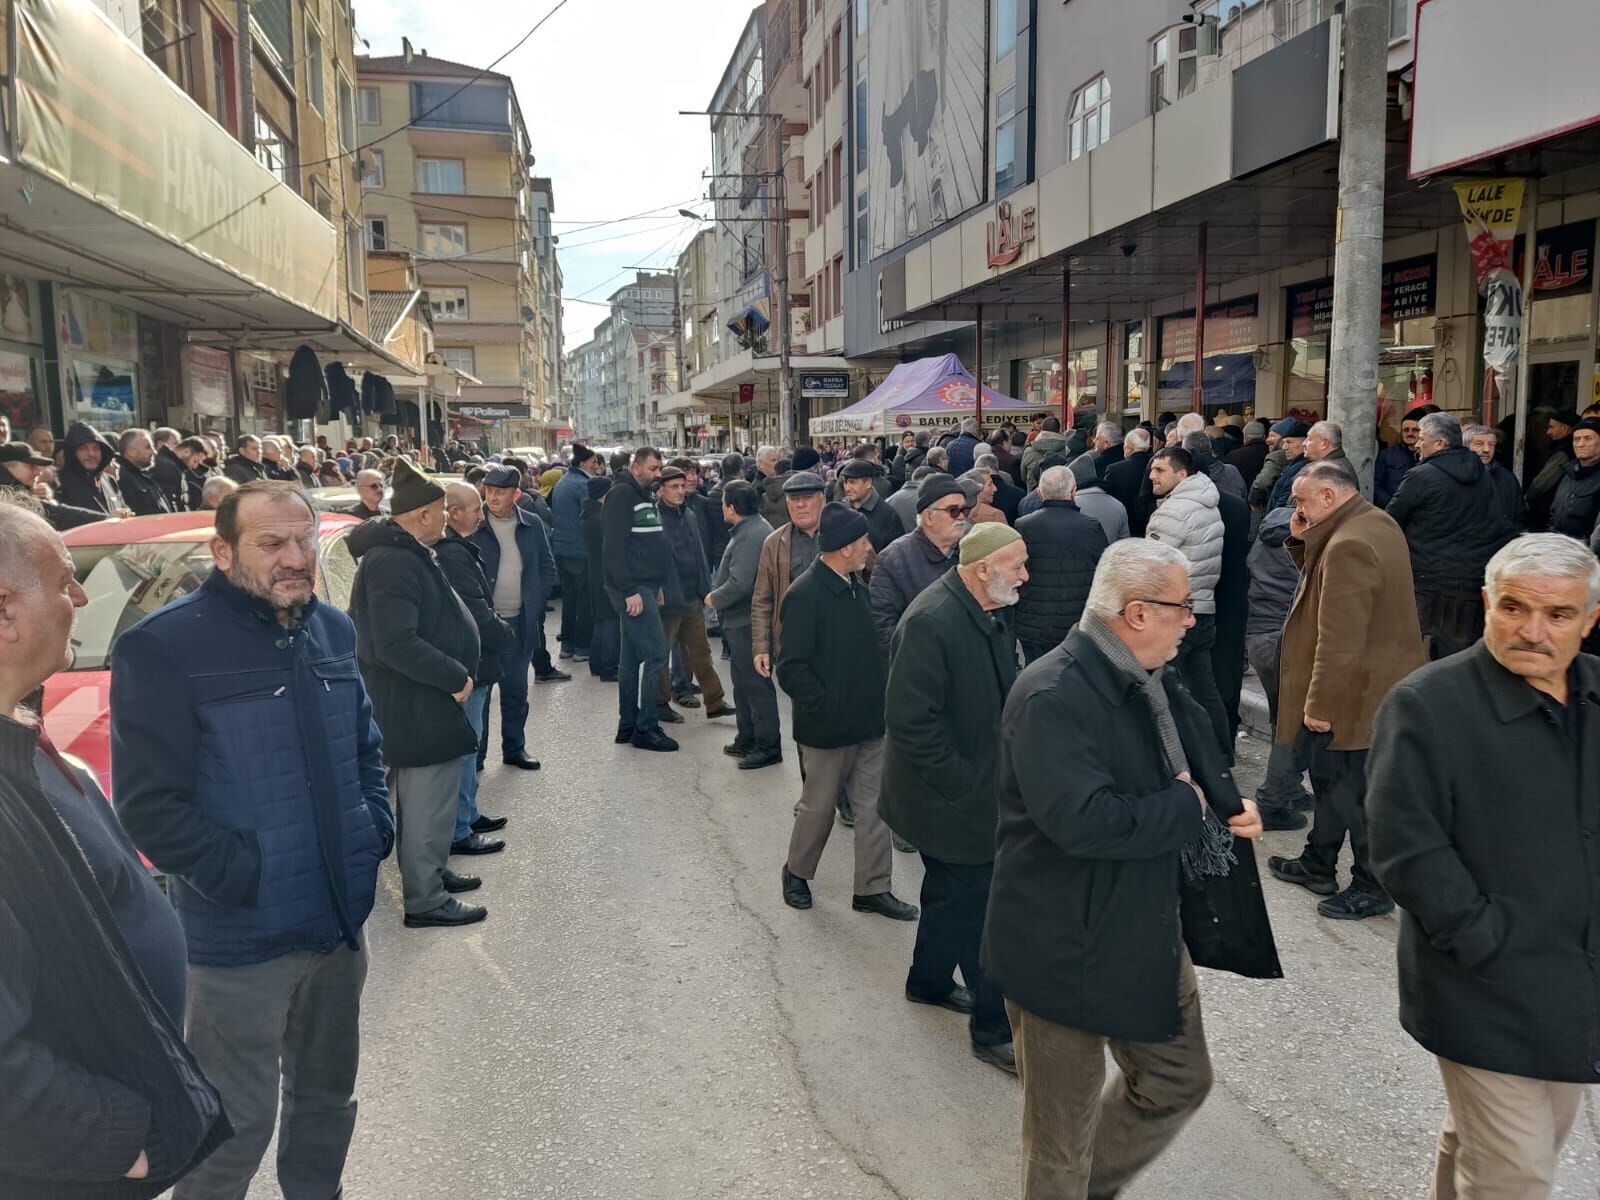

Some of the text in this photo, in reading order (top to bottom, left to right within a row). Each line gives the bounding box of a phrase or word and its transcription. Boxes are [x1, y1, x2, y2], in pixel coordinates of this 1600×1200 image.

[1467, 184, 1505, 203] LALE
[1394, 281, 1428, 295] FERACE
[1393, 293, 1428, 307] ABİYE
[1393, 306, 1428, 318] ELBİSE
[474, 406, 510, 416] Polisan
[919, 416, 959, 426] BAFRA
